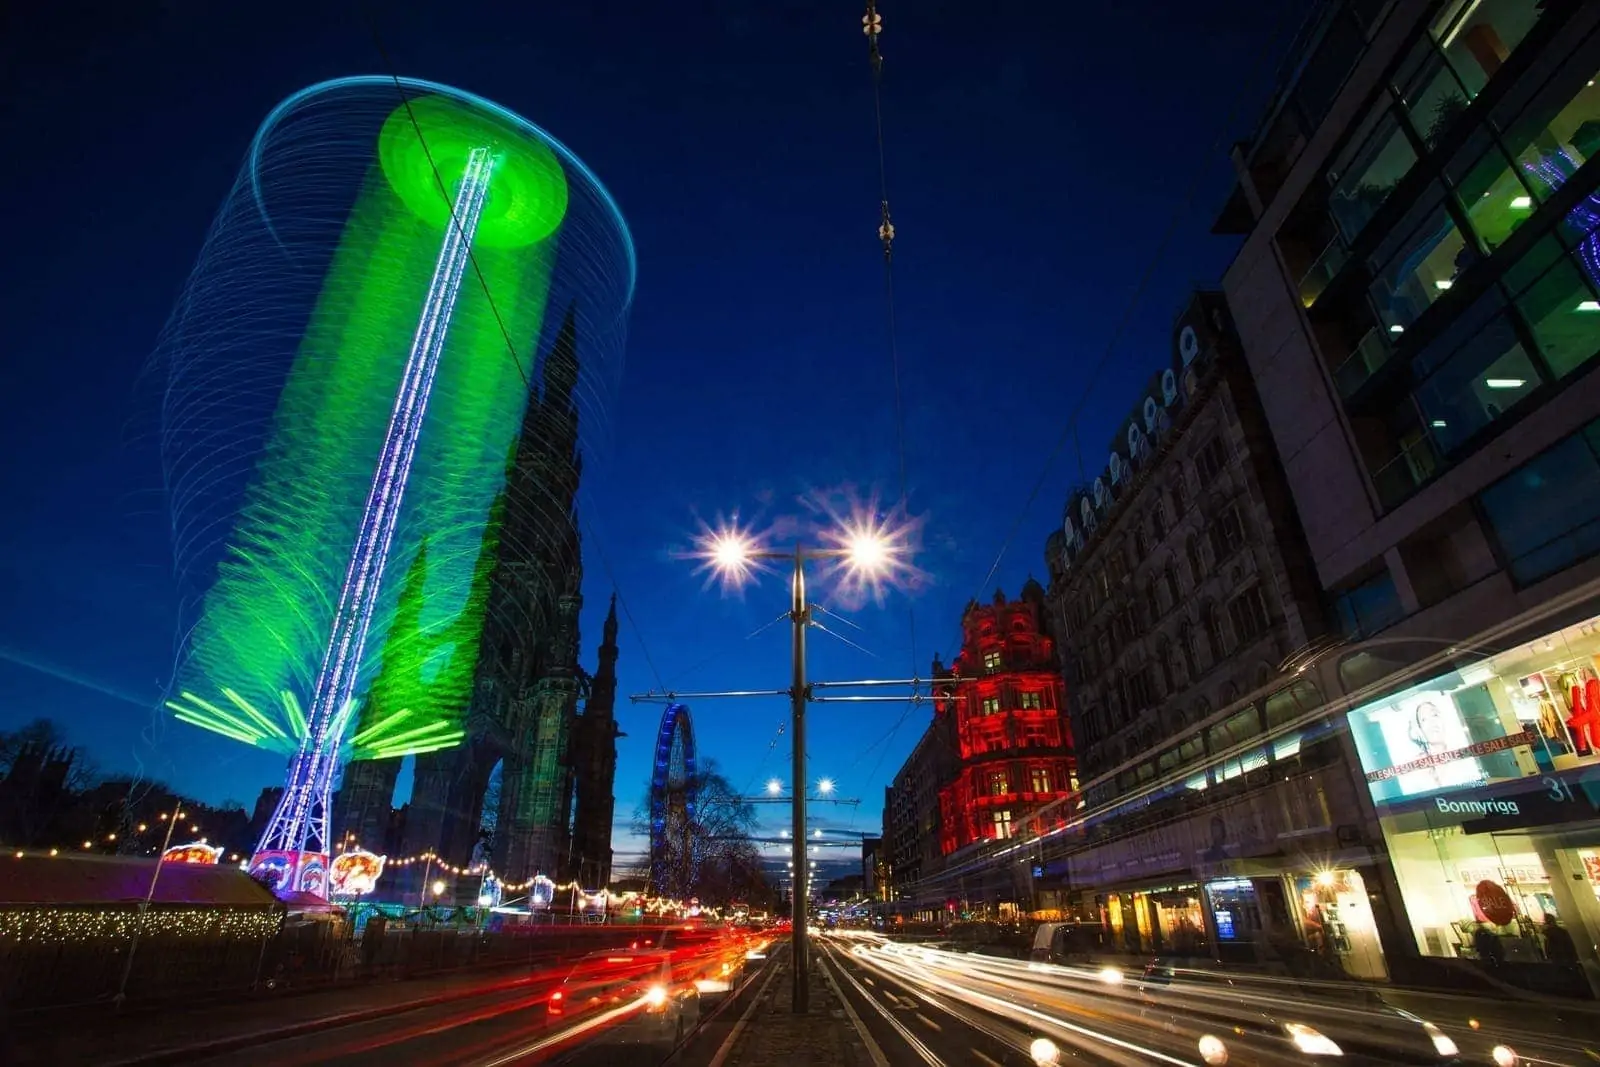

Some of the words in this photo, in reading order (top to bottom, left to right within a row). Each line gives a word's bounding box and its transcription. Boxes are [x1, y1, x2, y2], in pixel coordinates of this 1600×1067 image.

[1484, 739, 1507, 753] SALE
[1435, 797, 1520, 815] Bonnyrigg
[1542, 776, 1575, 803] 31
[1481, 895, 1508, 911] SALE
